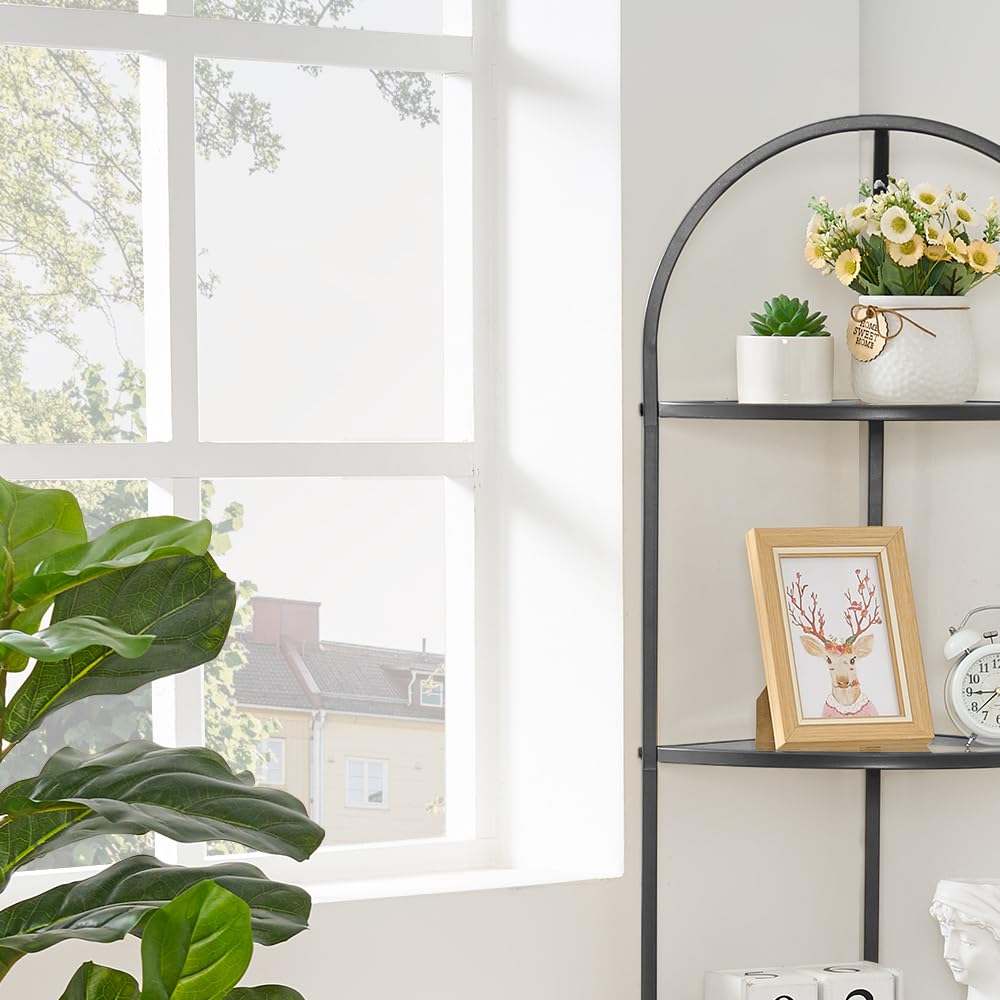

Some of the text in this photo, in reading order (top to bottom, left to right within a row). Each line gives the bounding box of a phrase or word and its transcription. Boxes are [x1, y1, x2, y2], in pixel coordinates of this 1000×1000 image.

[853, 327, 879, 341] SWEET
[856, 337, 874, 349] HOME
[980, 663, 989, 672] 11
[968, 674, 980, 684] 10
[966, 687, 973, 697] 9
[971, 702, 978, 712] 8
[982, 711, 989, 720] 7
